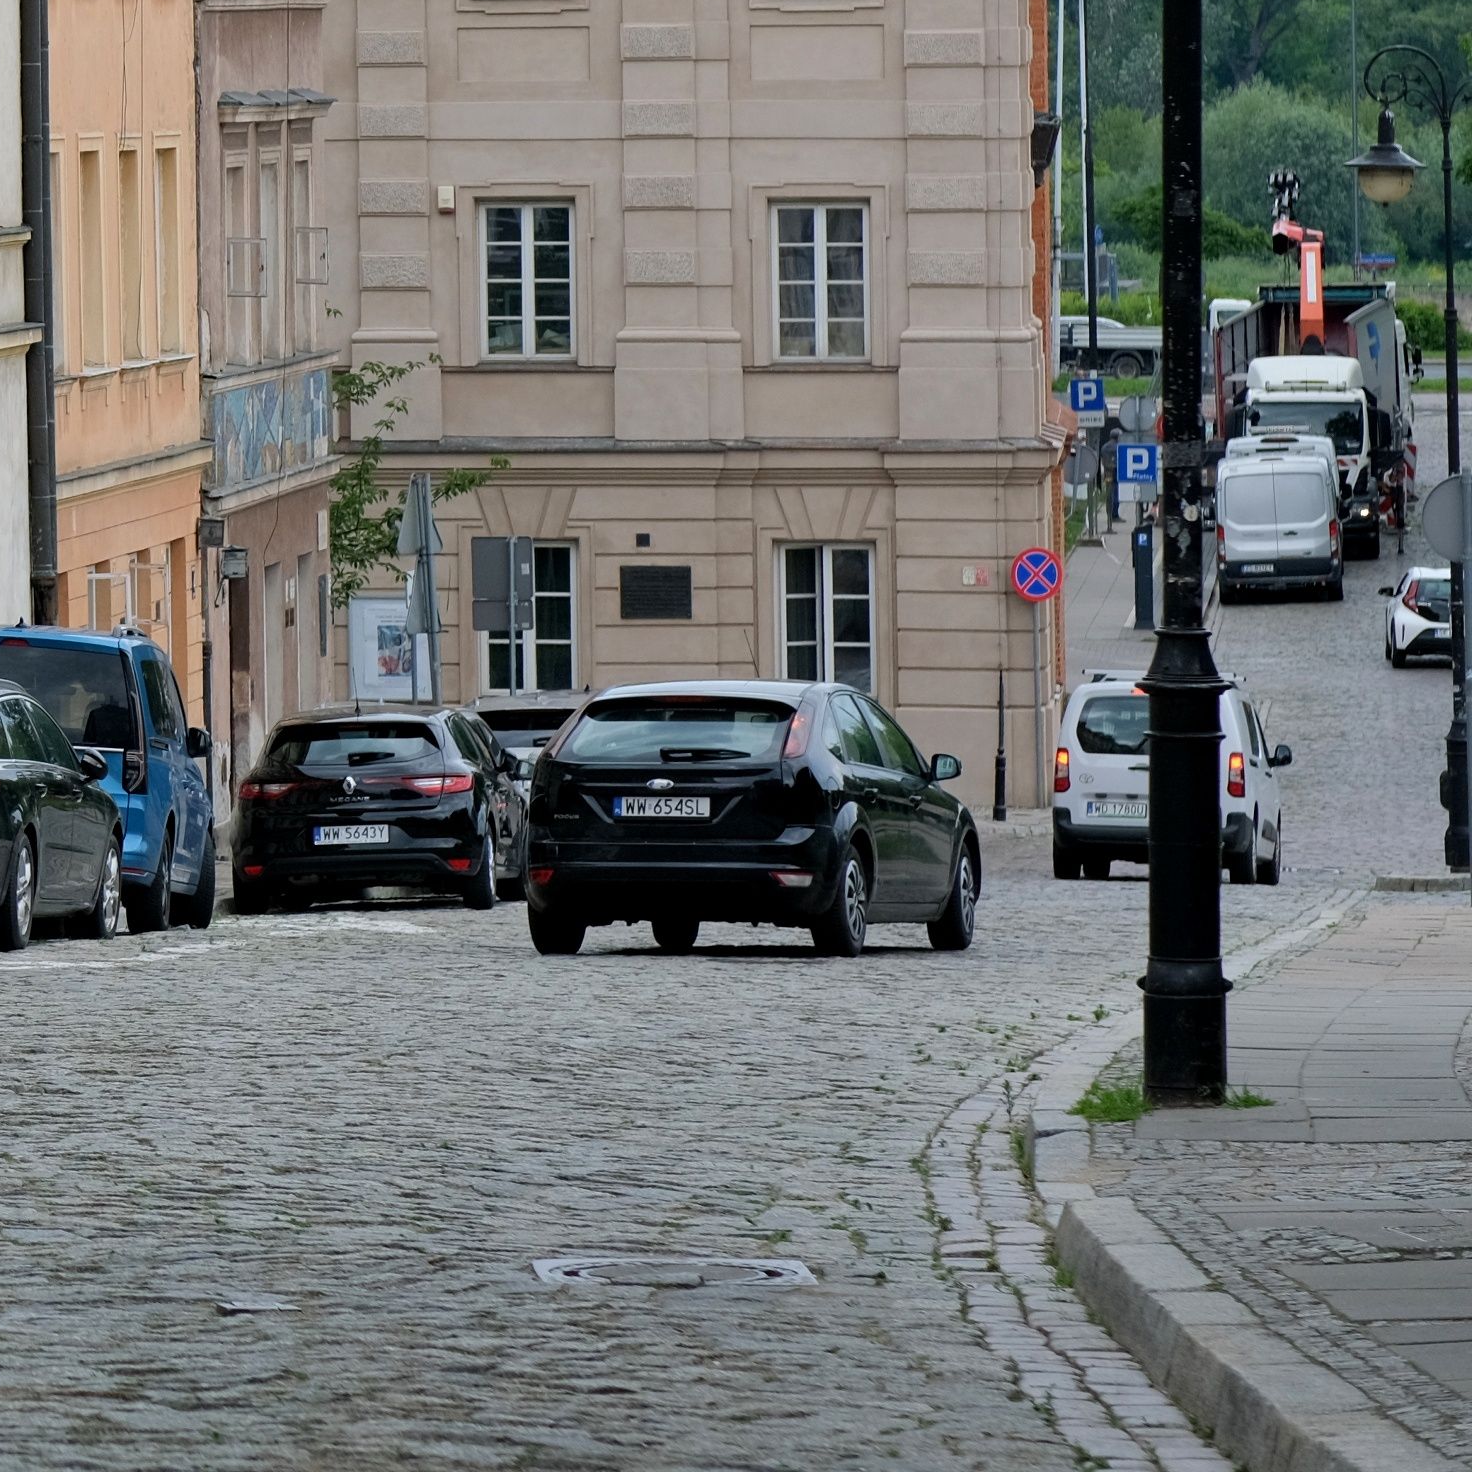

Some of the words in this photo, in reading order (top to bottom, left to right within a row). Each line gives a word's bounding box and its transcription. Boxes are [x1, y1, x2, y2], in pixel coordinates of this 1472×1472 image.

[1077, 381, 1097, 408] P
[1127, 448, 1149, 479] P
[625, 799, 647, 815] WW
[653, 799, 705, 816] 654SL
[323, 828, 340, 841] WW
[345, 826, 385, 839] 5643Y
